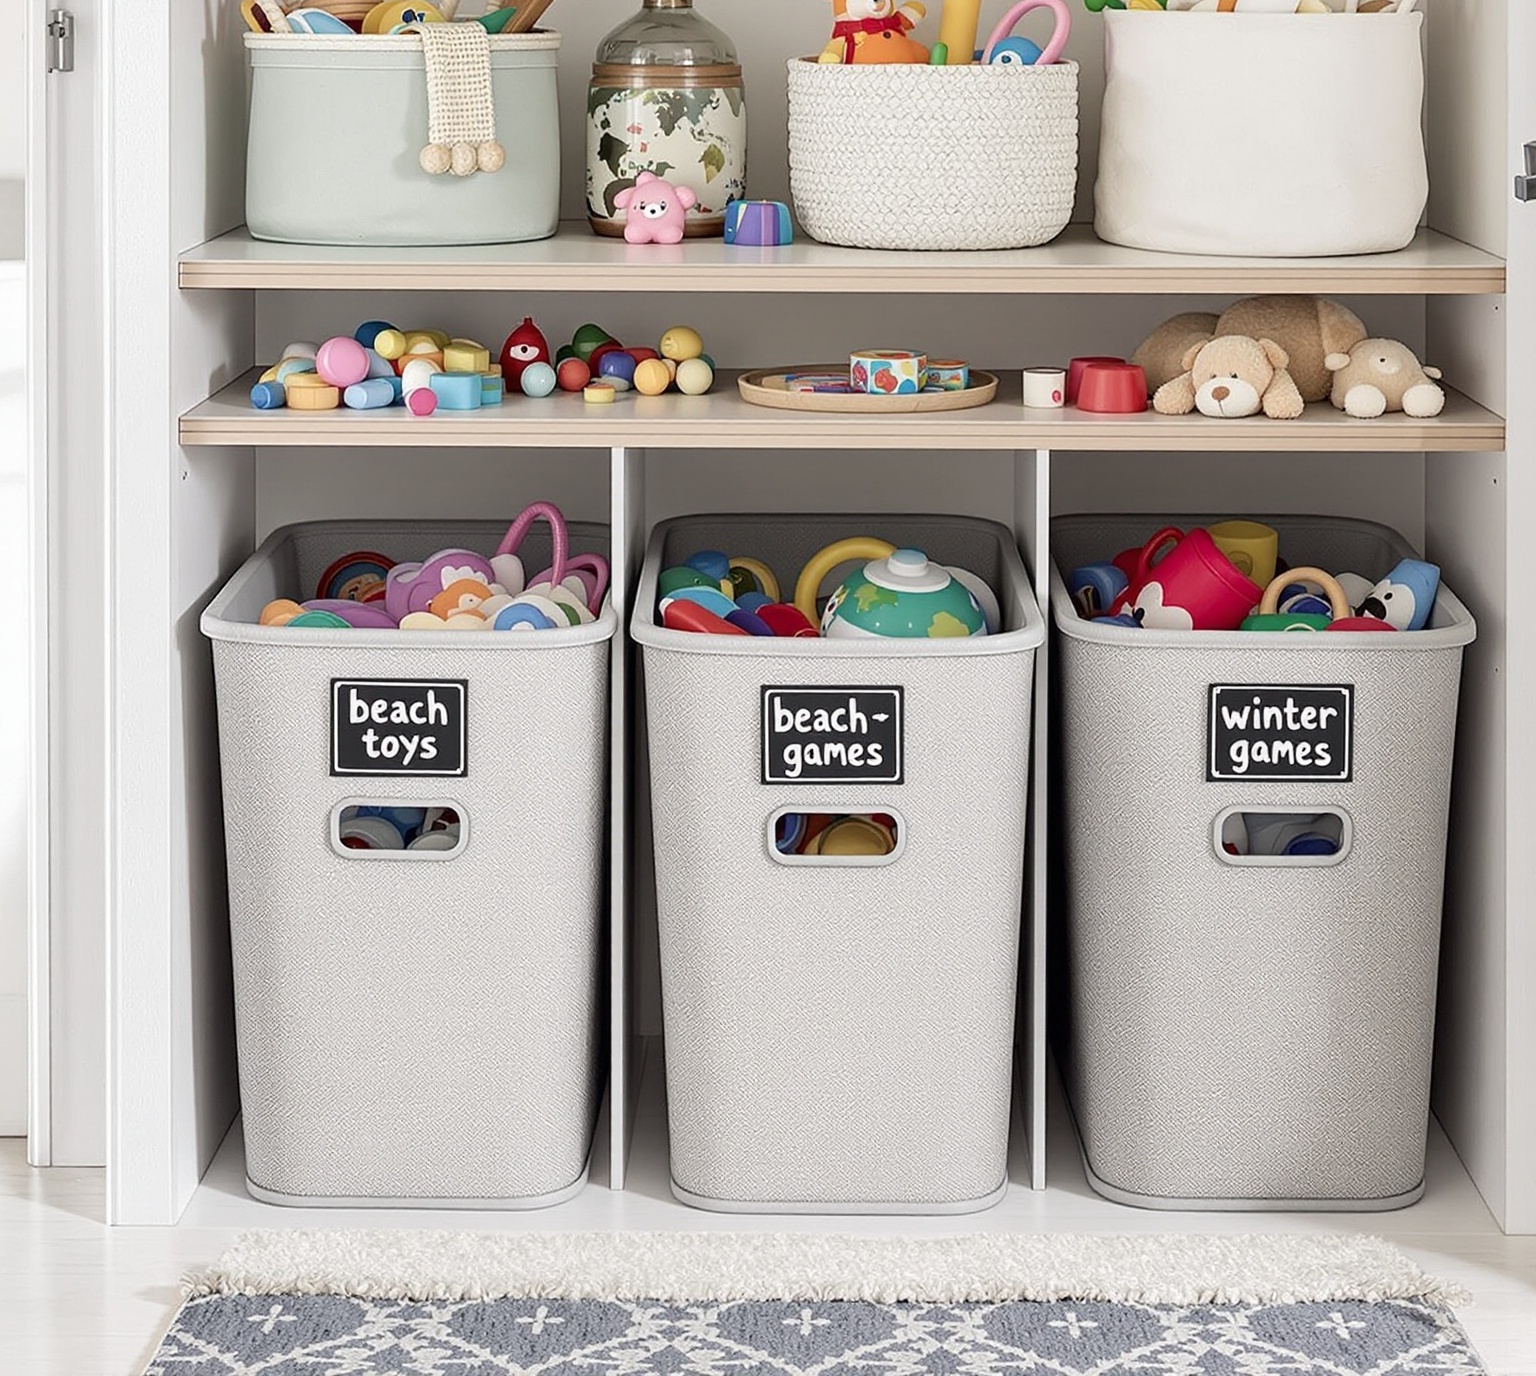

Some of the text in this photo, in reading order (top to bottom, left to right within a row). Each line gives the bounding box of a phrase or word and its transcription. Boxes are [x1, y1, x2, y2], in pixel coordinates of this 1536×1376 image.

[349, 688, 448, 726] beach
[1221, 696, 1338, 731] winter
[361, 728, 438, 766] toys
[783, 742, 883, 778] games
[1229, 739, 1332, 774] games
